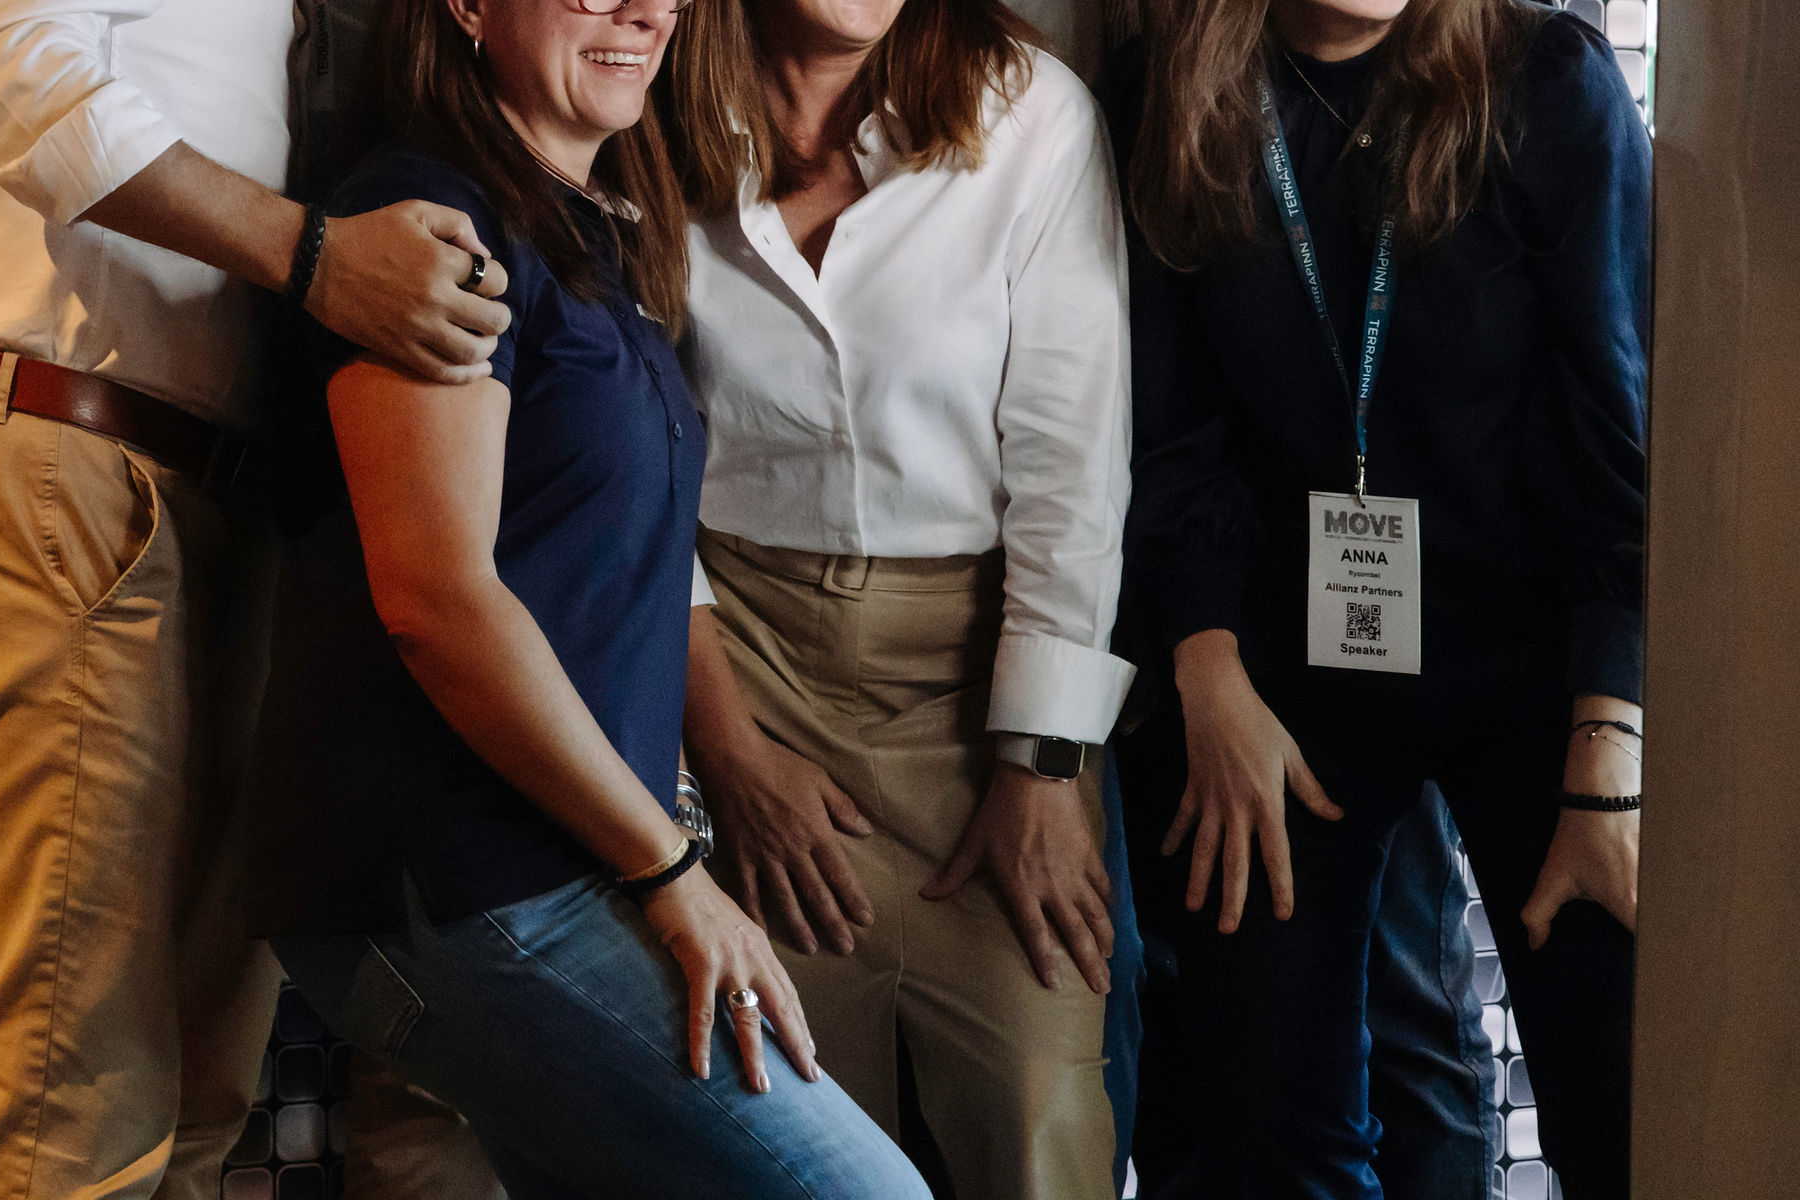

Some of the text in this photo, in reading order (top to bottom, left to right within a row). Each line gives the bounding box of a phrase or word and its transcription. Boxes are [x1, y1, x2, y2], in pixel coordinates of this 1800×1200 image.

[1270, 137, 1299, 218] TERRAPINN
[1359, 319, 1380, 400] TERRAPINN
[1324, 509, 1404, 539] MOVE
[1340, 548, 1389, 566] ANNA
[1325, 582, 1404, 598] Allianz Partners
[1340, 642, 1388, 658] Speaker
